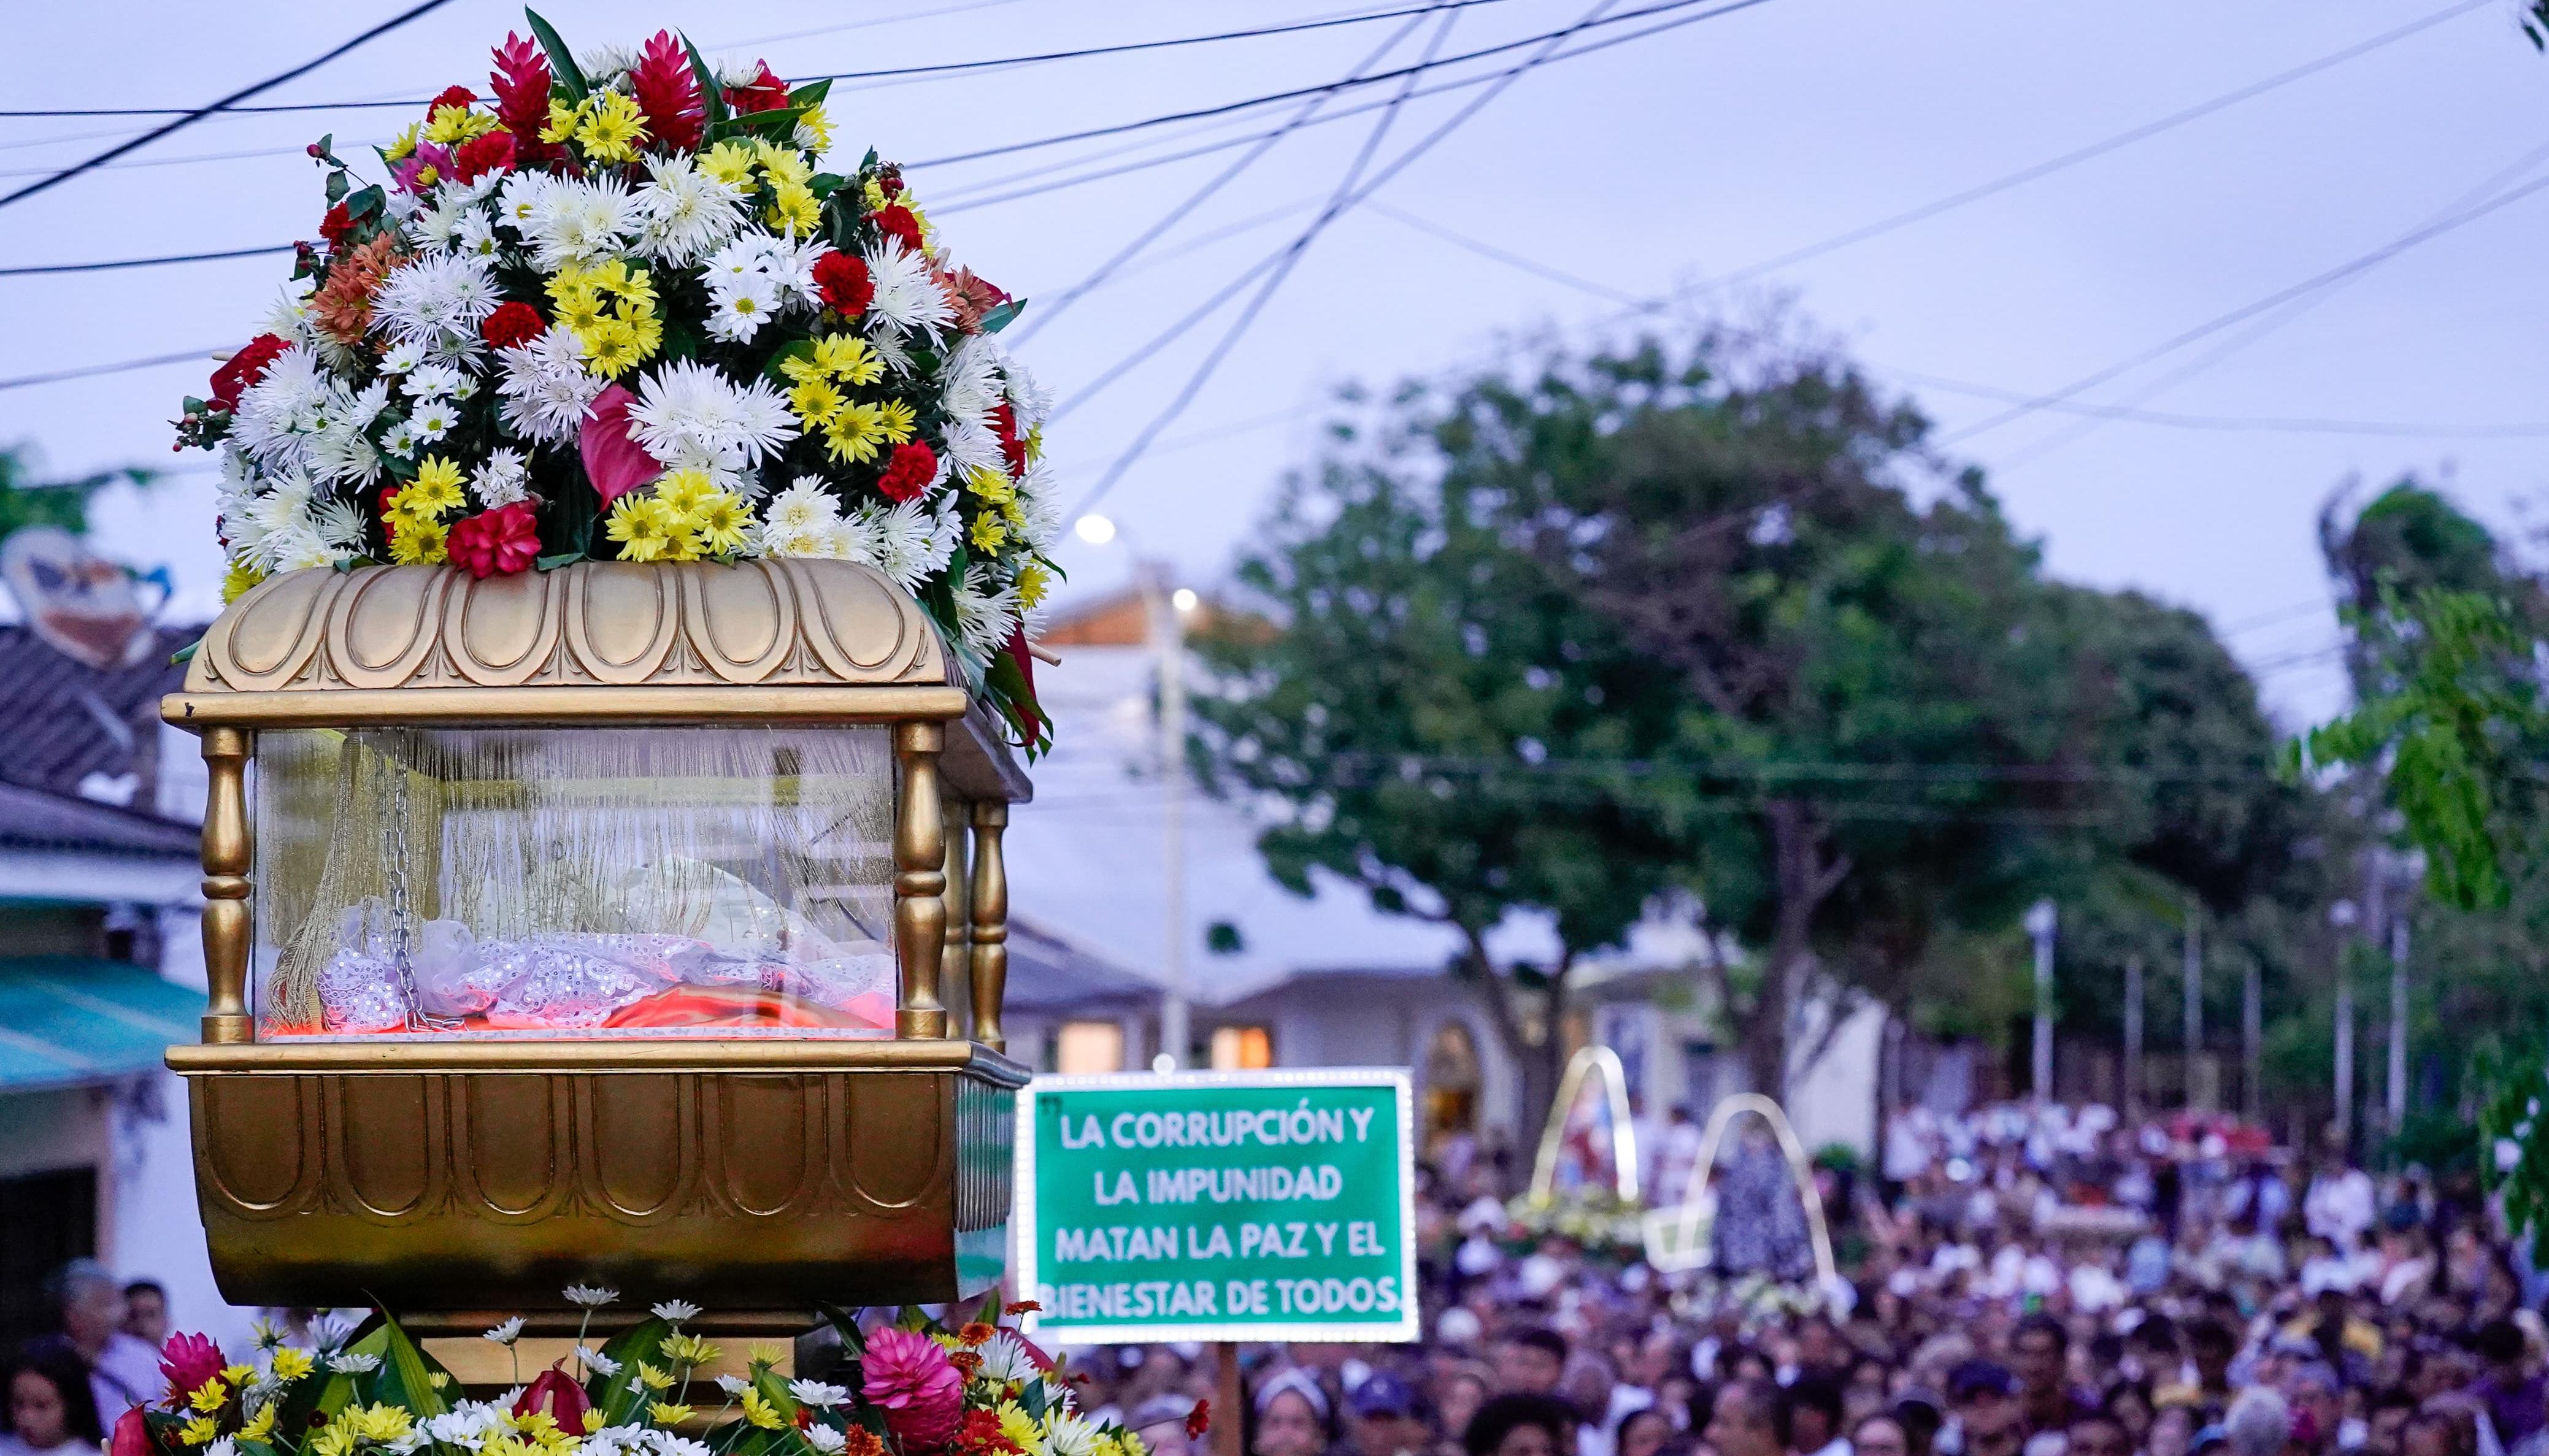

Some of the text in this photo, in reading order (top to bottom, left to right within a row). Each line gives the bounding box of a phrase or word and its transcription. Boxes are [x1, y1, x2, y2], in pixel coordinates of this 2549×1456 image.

[1062, 1099, 1373, 1148] LA CORRUPCIÓN Y
[1096, 1166, 1341, 1204] LA IMPUNIDAD
[1056, 1222, 1384, 1260] MATAN LA PAZ Y EL
[1038, 1280, 1218, 1319] BIENESTAR
[1228, 1281, 1268, 1314] DE
